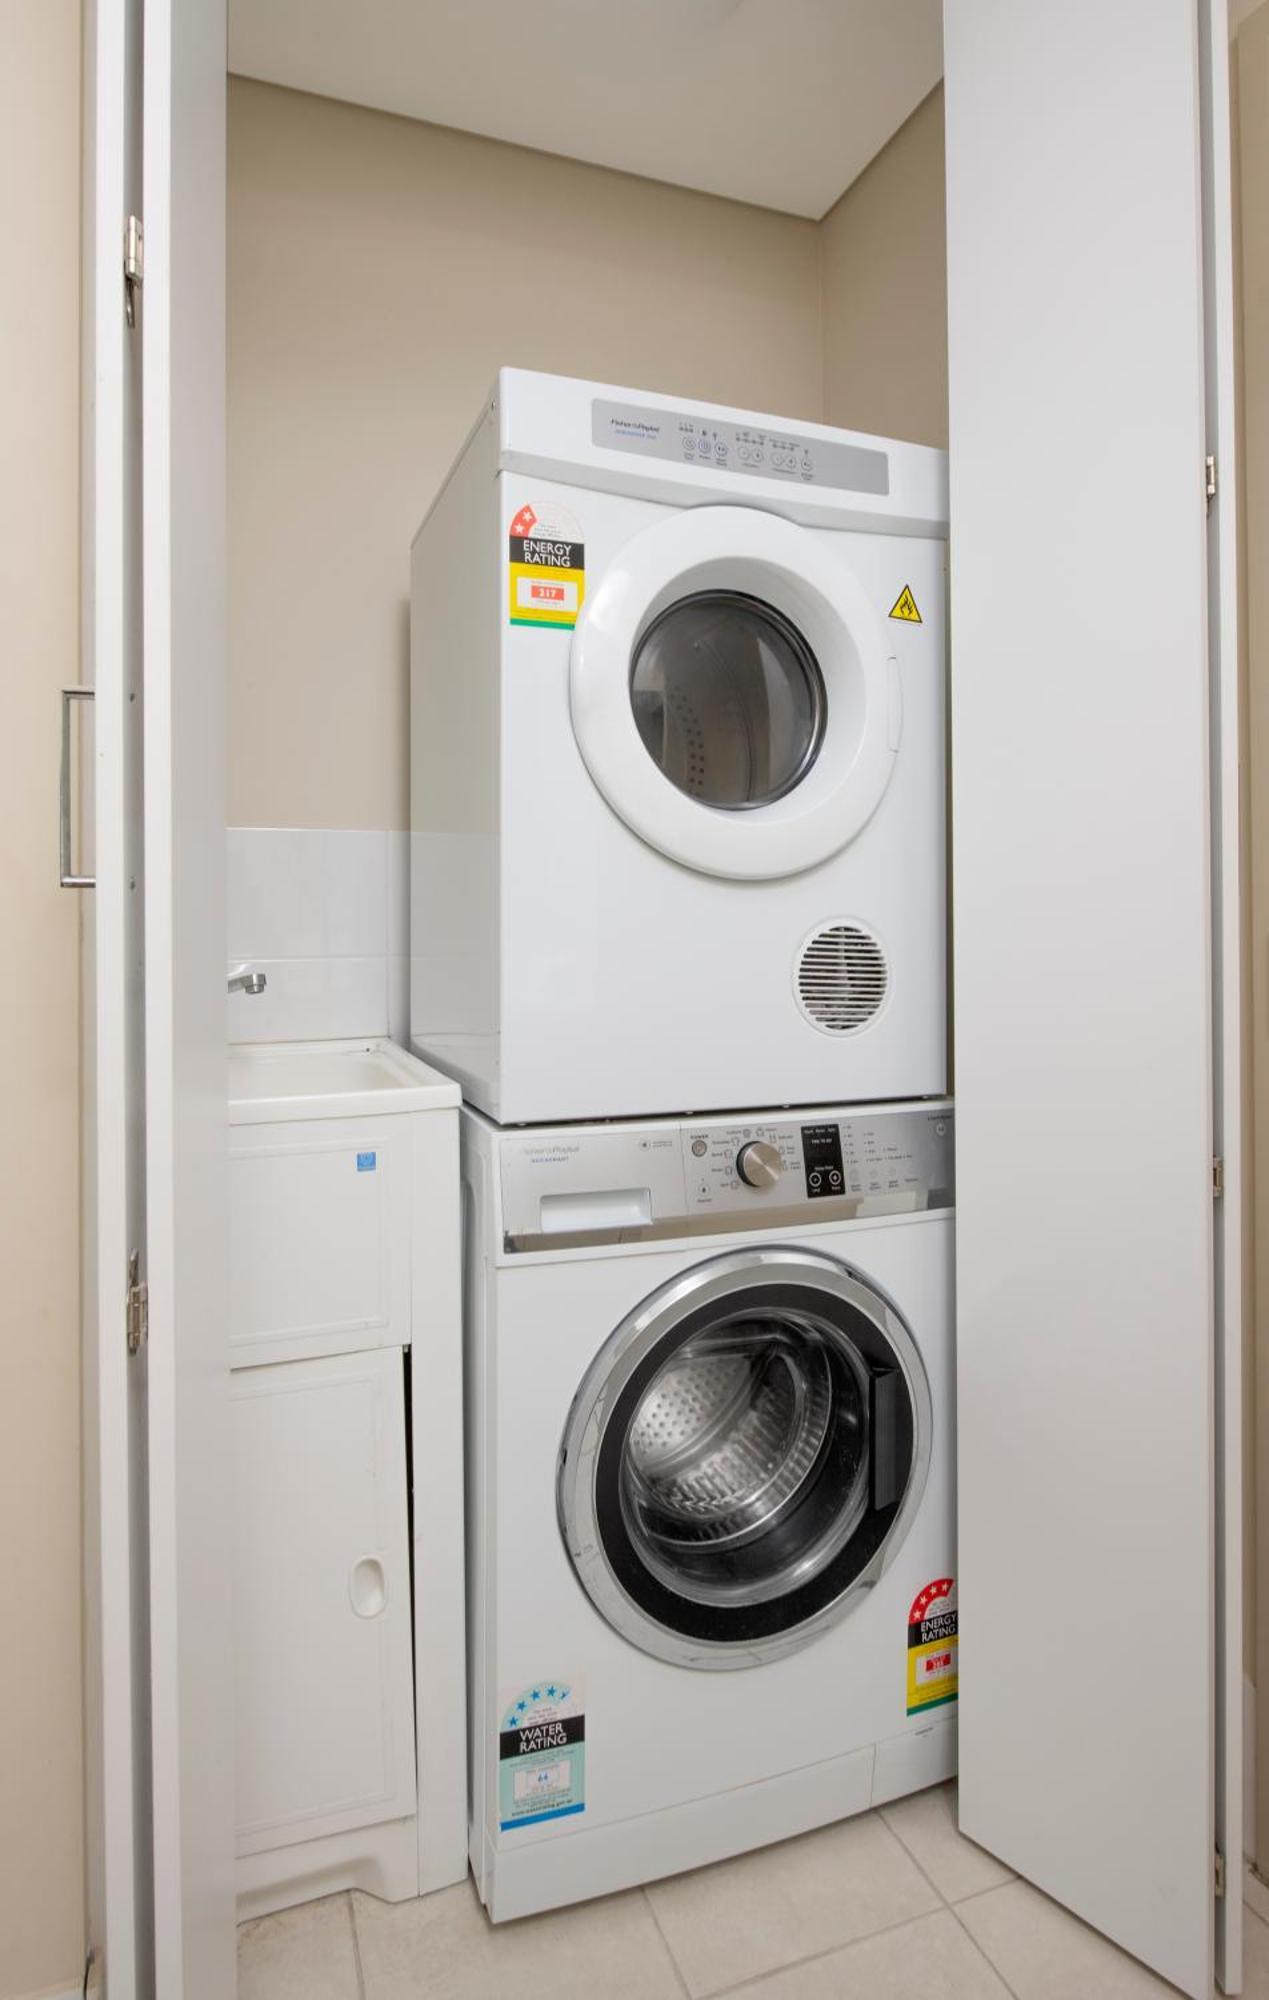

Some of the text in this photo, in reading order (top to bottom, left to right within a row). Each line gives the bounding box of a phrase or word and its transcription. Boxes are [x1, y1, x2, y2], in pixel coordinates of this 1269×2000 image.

[523, 540, 572, 557] ENERGY
[524, 552, 571, 568] RATING
[538, 588, 557, 598] 217
[920, 1610, 957, 1632] ENERGY
[921, 1623, 957, 1643] RATING
[520, 1722, 564, 1742] WATER
[519, 1733, 567, 1753] RATING
